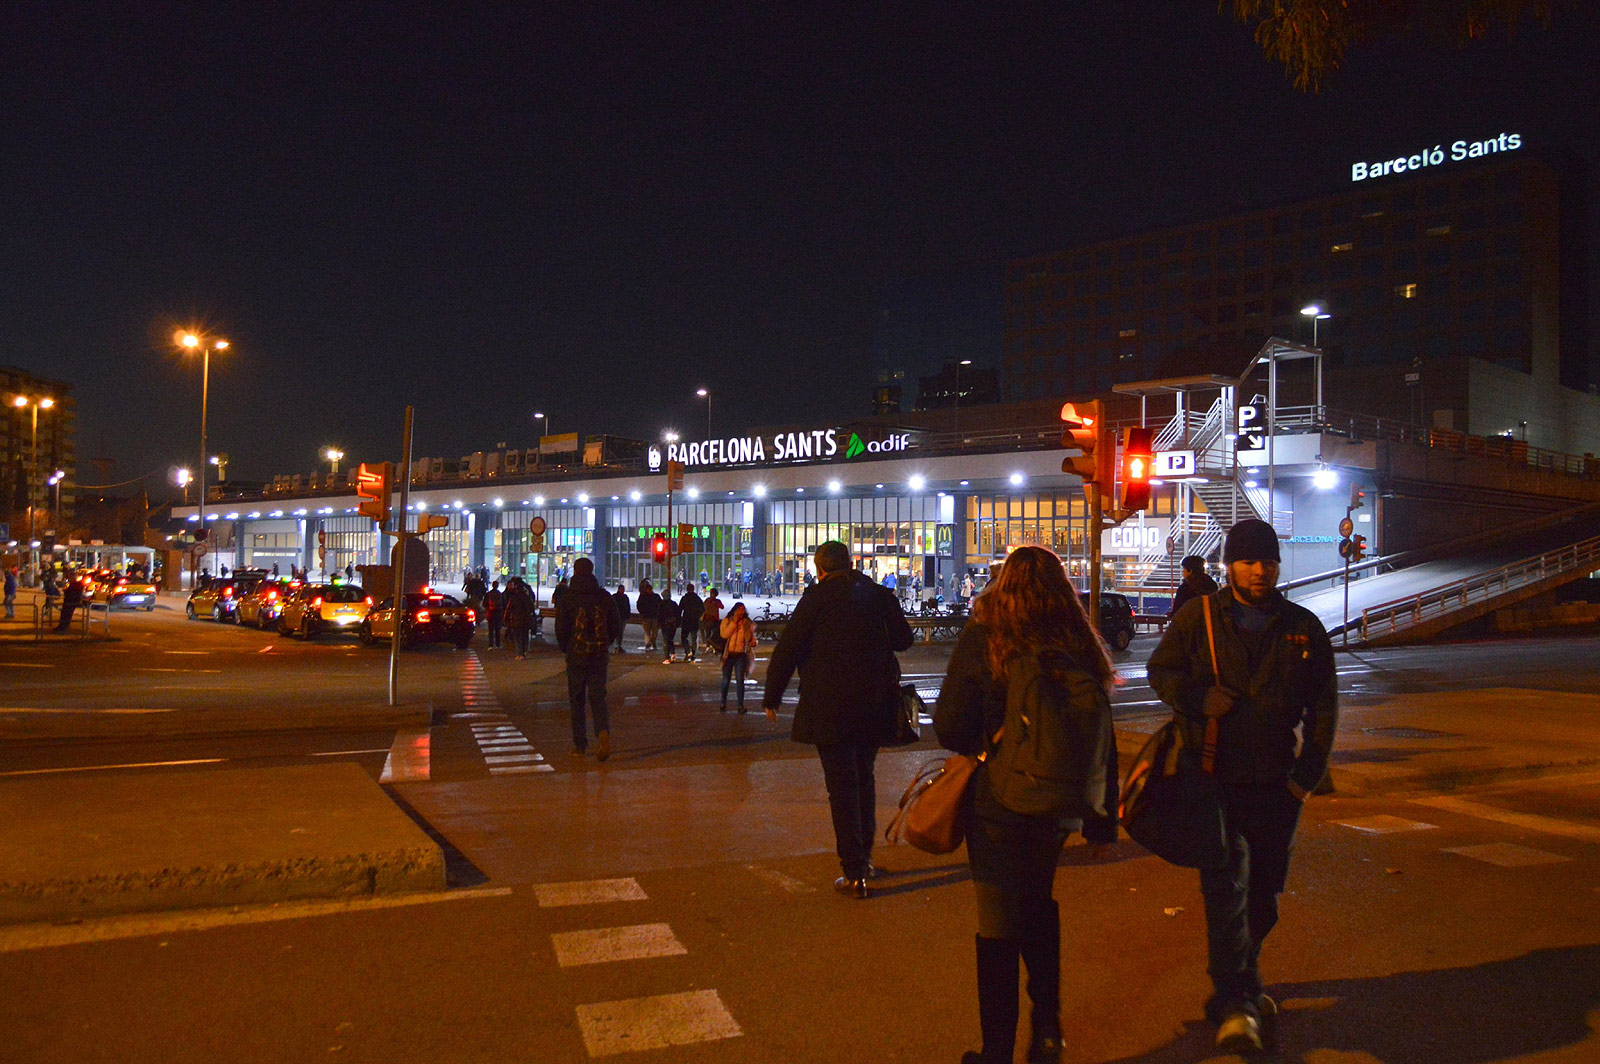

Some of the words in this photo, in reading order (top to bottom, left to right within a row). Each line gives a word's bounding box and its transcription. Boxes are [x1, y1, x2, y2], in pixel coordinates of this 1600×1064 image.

[1352, 145, 1443, 182] Barceló
[1450, 132, 1522, 161] Sants
[1239, 406, 1256, 427] P
[667, 436, 766, 467] BARCELONA
[774, 428, 837, 459] SANTS
[867, 433, 911, 453] adif
[1172, 456, 1183, 467] P
